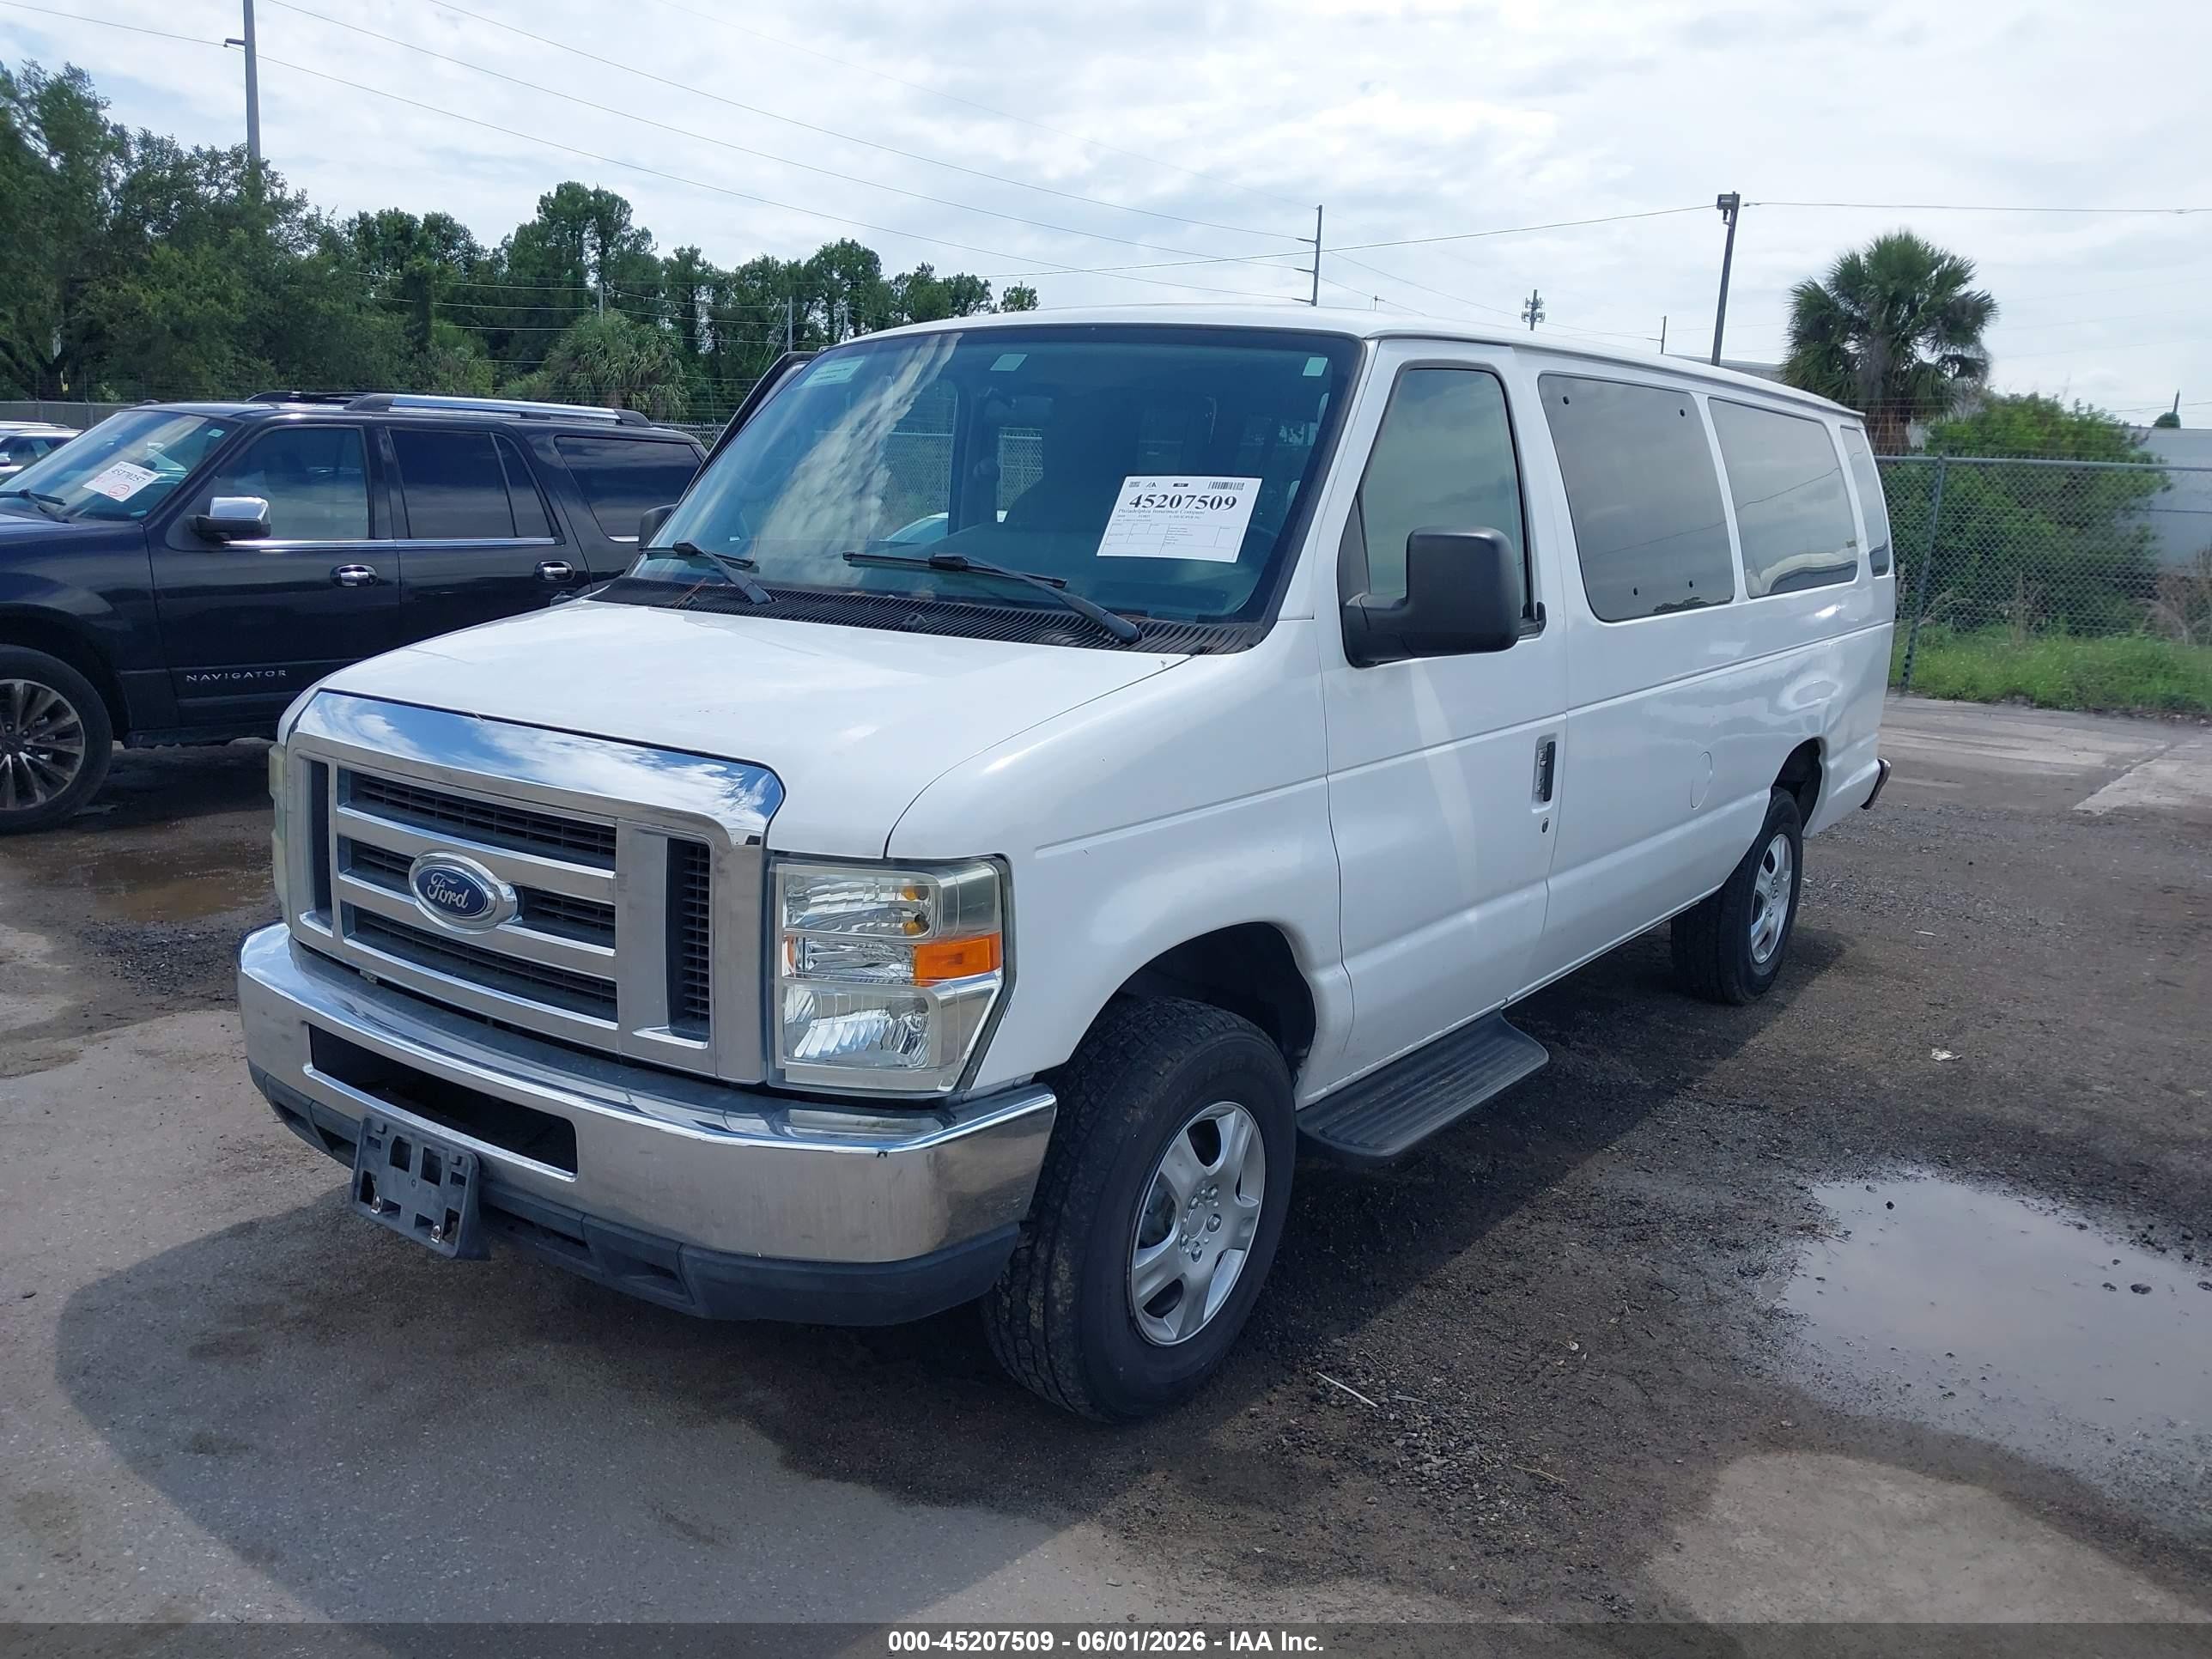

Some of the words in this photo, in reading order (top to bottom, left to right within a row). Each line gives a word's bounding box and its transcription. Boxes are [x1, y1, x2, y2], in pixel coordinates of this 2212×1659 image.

[1129, 494, 1237, 511] 45207509
[186, 670, 287, 683] NAVIGATOR
[428, 872, 470, 908] Ford
